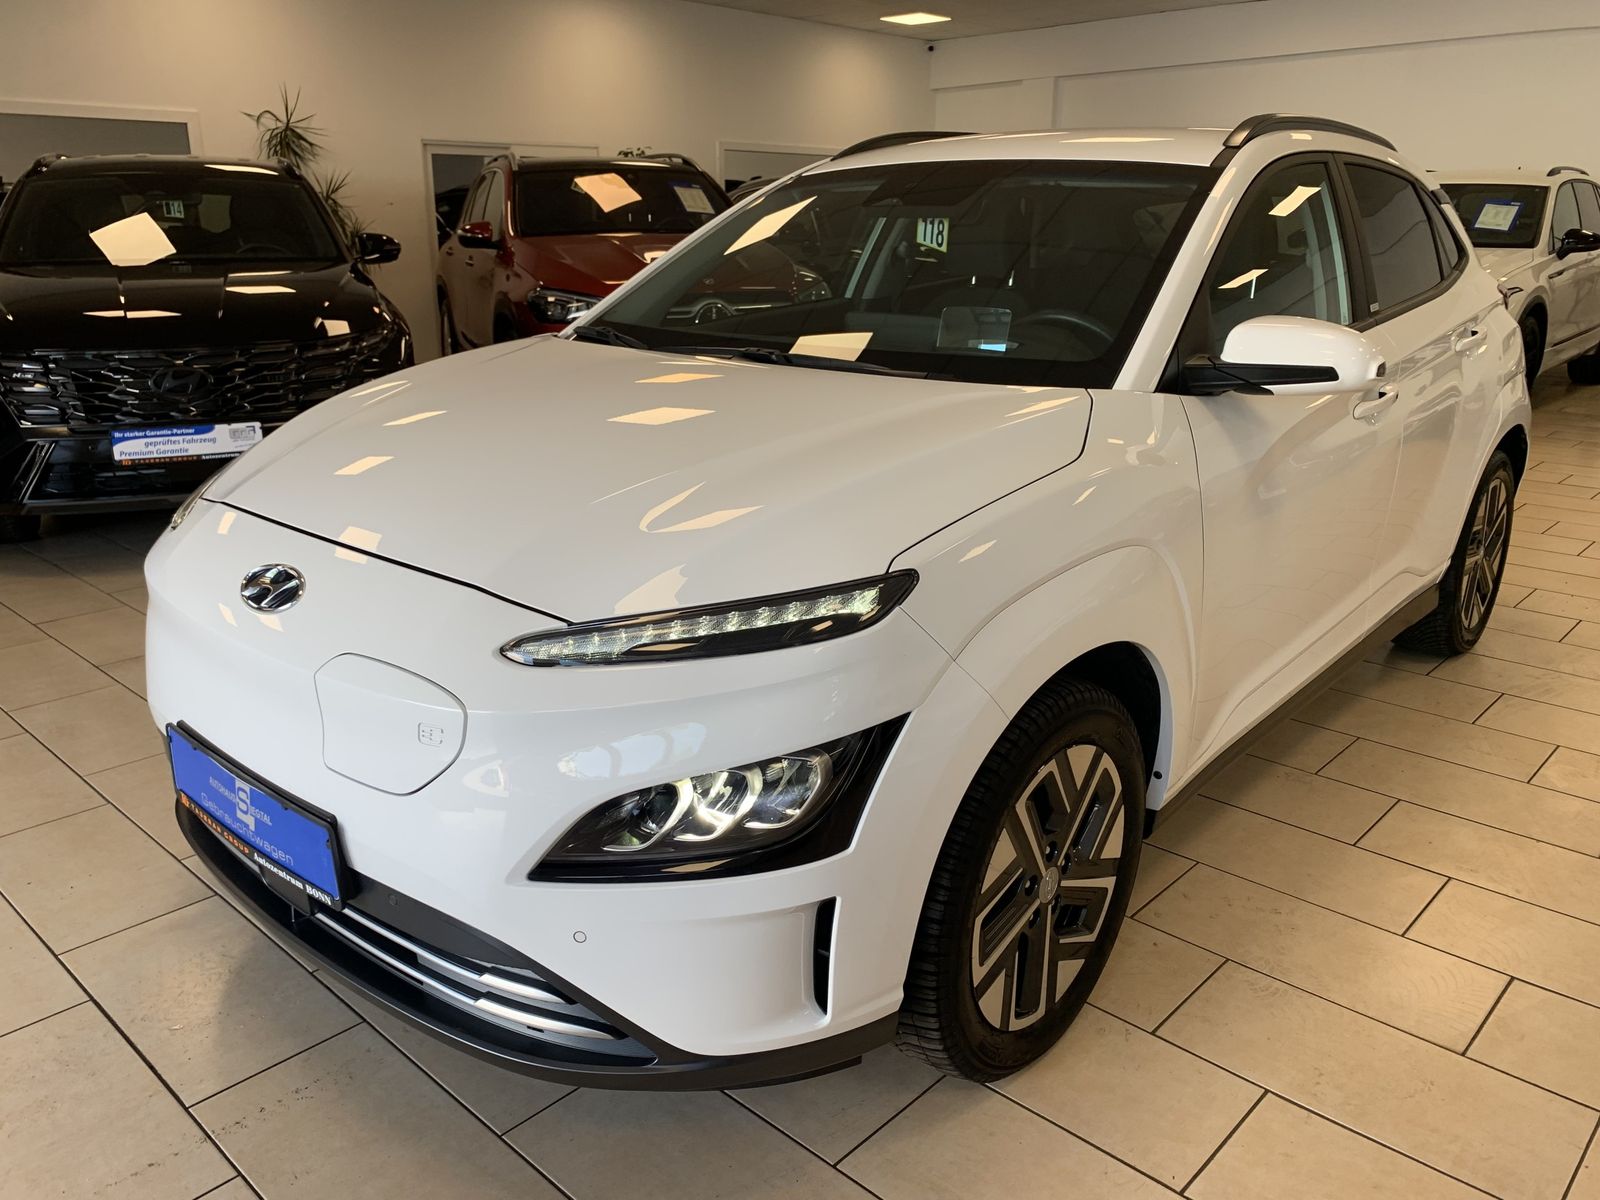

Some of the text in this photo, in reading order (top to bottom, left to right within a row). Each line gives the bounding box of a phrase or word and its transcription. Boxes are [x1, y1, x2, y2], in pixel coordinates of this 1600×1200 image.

[921, 217, 945, 248] 118
[144, 439, 181, 448] geprüftes
[156, 447, 189, 455] Garantie
[254, 852, 304, 889] Autozentrum
[305, 884, 331, 905] BONN
